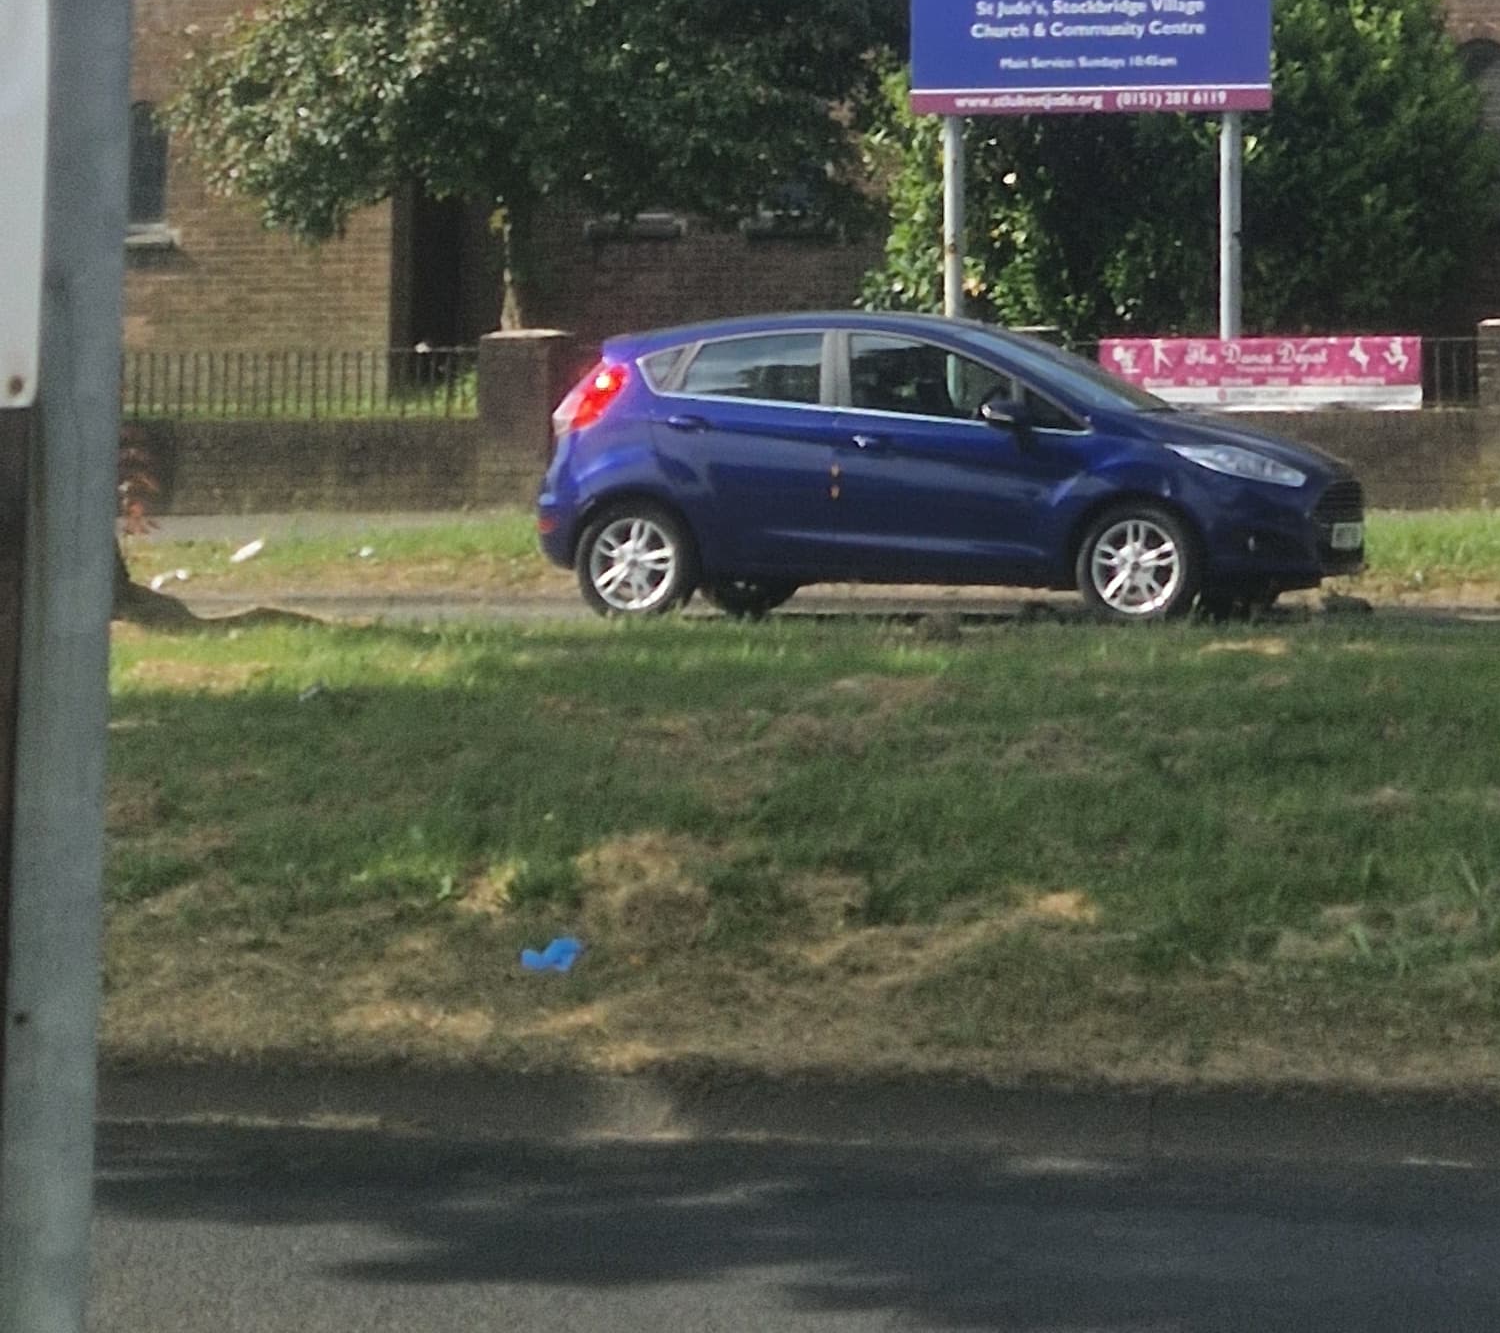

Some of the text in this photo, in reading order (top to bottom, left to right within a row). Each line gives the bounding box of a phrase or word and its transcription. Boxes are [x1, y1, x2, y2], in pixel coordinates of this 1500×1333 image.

[976, 0, 994, 16] St
[996, 0, 1049, 19] Jude's,
[970, 19, 1206, 39] Church & Community Centre
